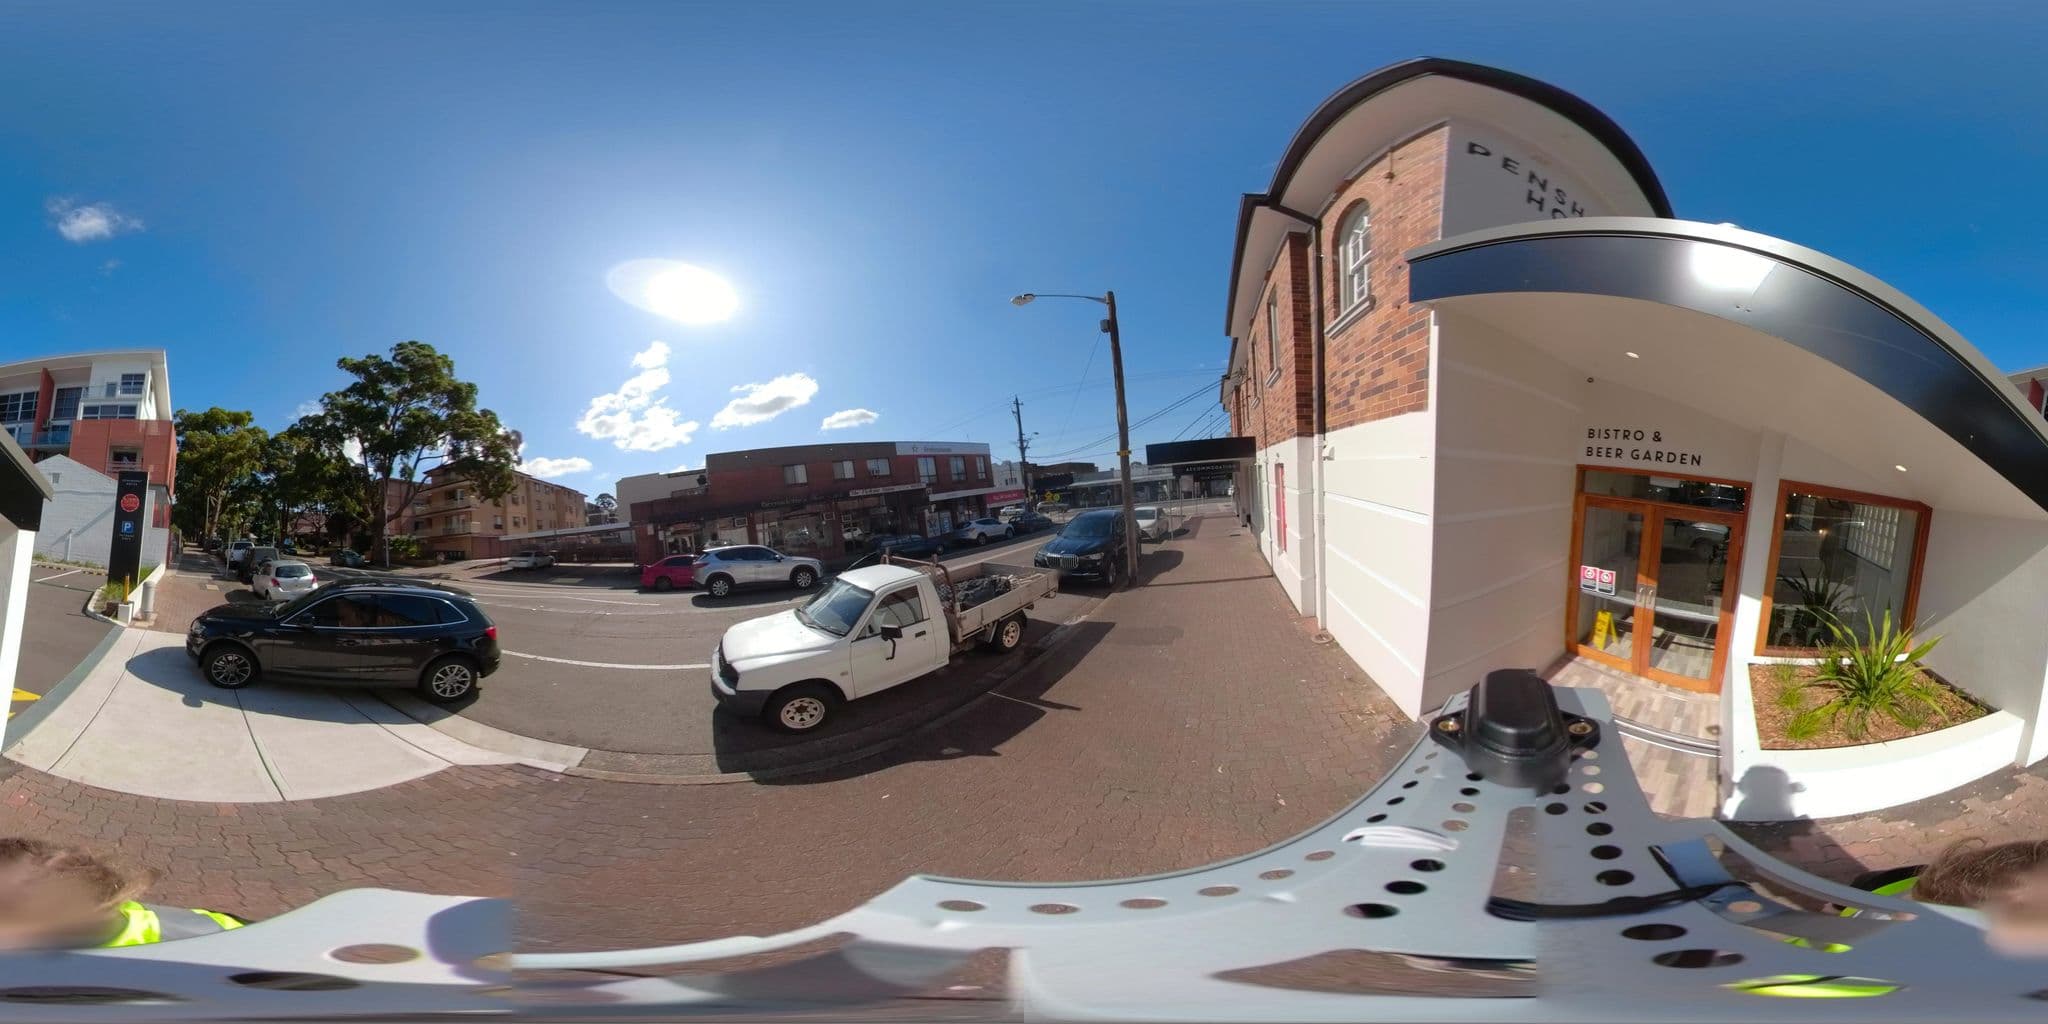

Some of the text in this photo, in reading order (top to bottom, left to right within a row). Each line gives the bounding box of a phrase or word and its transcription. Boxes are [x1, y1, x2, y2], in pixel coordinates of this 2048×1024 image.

[1467, 141, 1584, 217] PENSH
[1588, 428, 1662, 442] BISTRO &
[1586, 446, 1701, 466] BEER GARDEN
